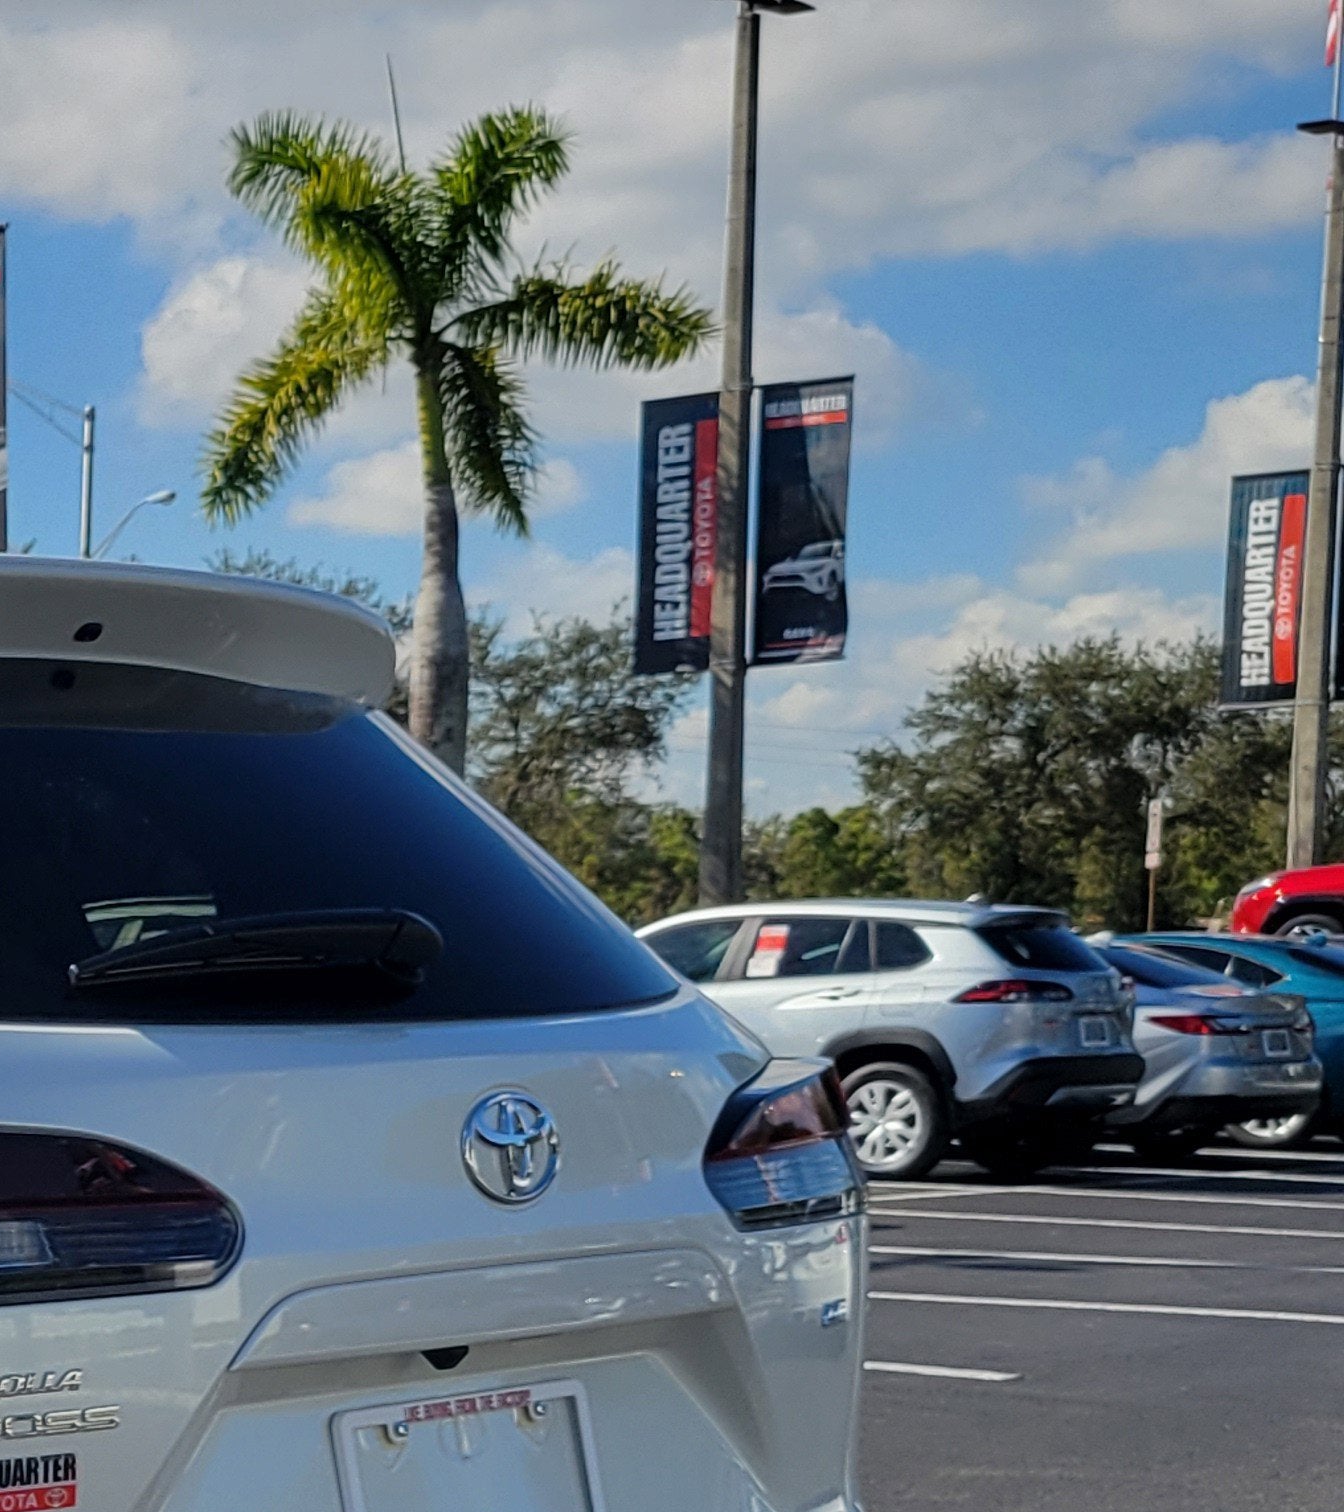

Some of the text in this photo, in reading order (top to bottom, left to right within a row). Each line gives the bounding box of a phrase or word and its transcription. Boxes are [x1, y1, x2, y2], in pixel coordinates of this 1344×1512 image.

[653, 422, 695, 641] HEADQUARTER
[696, 477, 716, 558] TOYOTA
[1277, 545, 1297, 617] TOYOTA
[1240, 497, 1280, 687] HEADQUARTER
